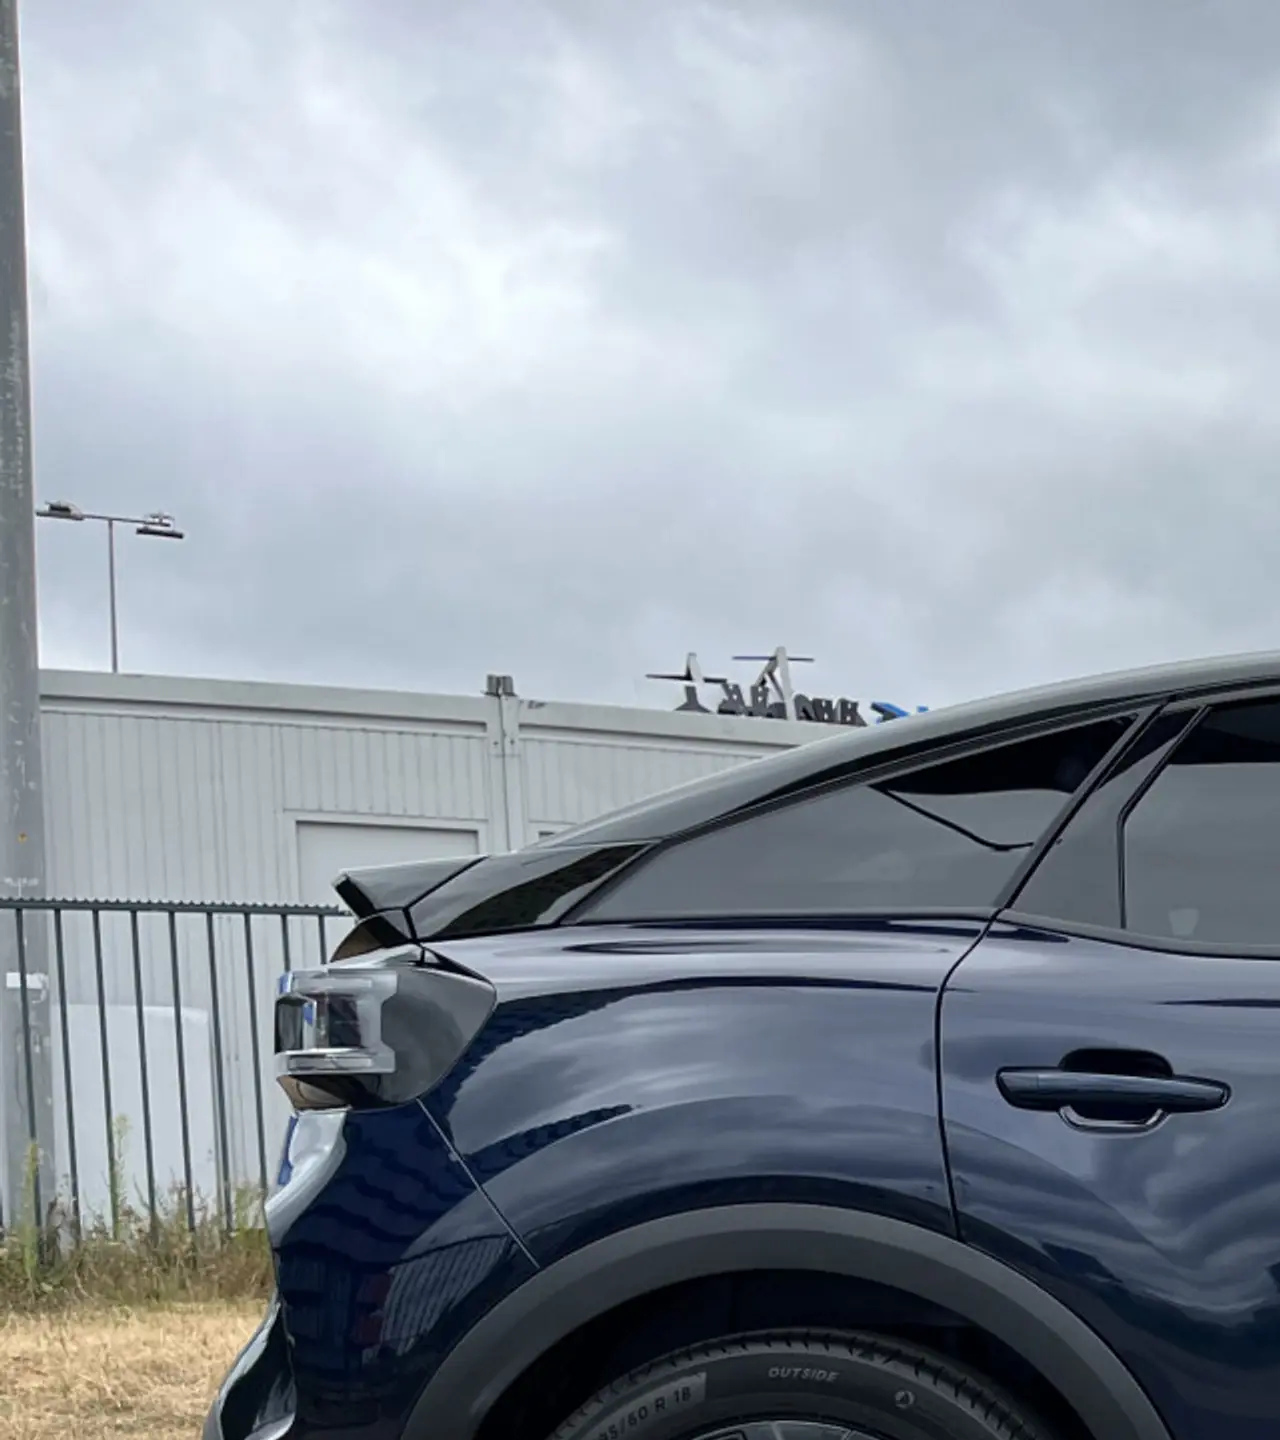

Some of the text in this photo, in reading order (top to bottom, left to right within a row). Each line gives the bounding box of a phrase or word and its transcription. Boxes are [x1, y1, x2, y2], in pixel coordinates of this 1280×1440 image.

[768, 1366, 840, 1383] OUTSIDE
[655, 1395, 667, 1411] R
[675, 1387, 691, 1404] 18
